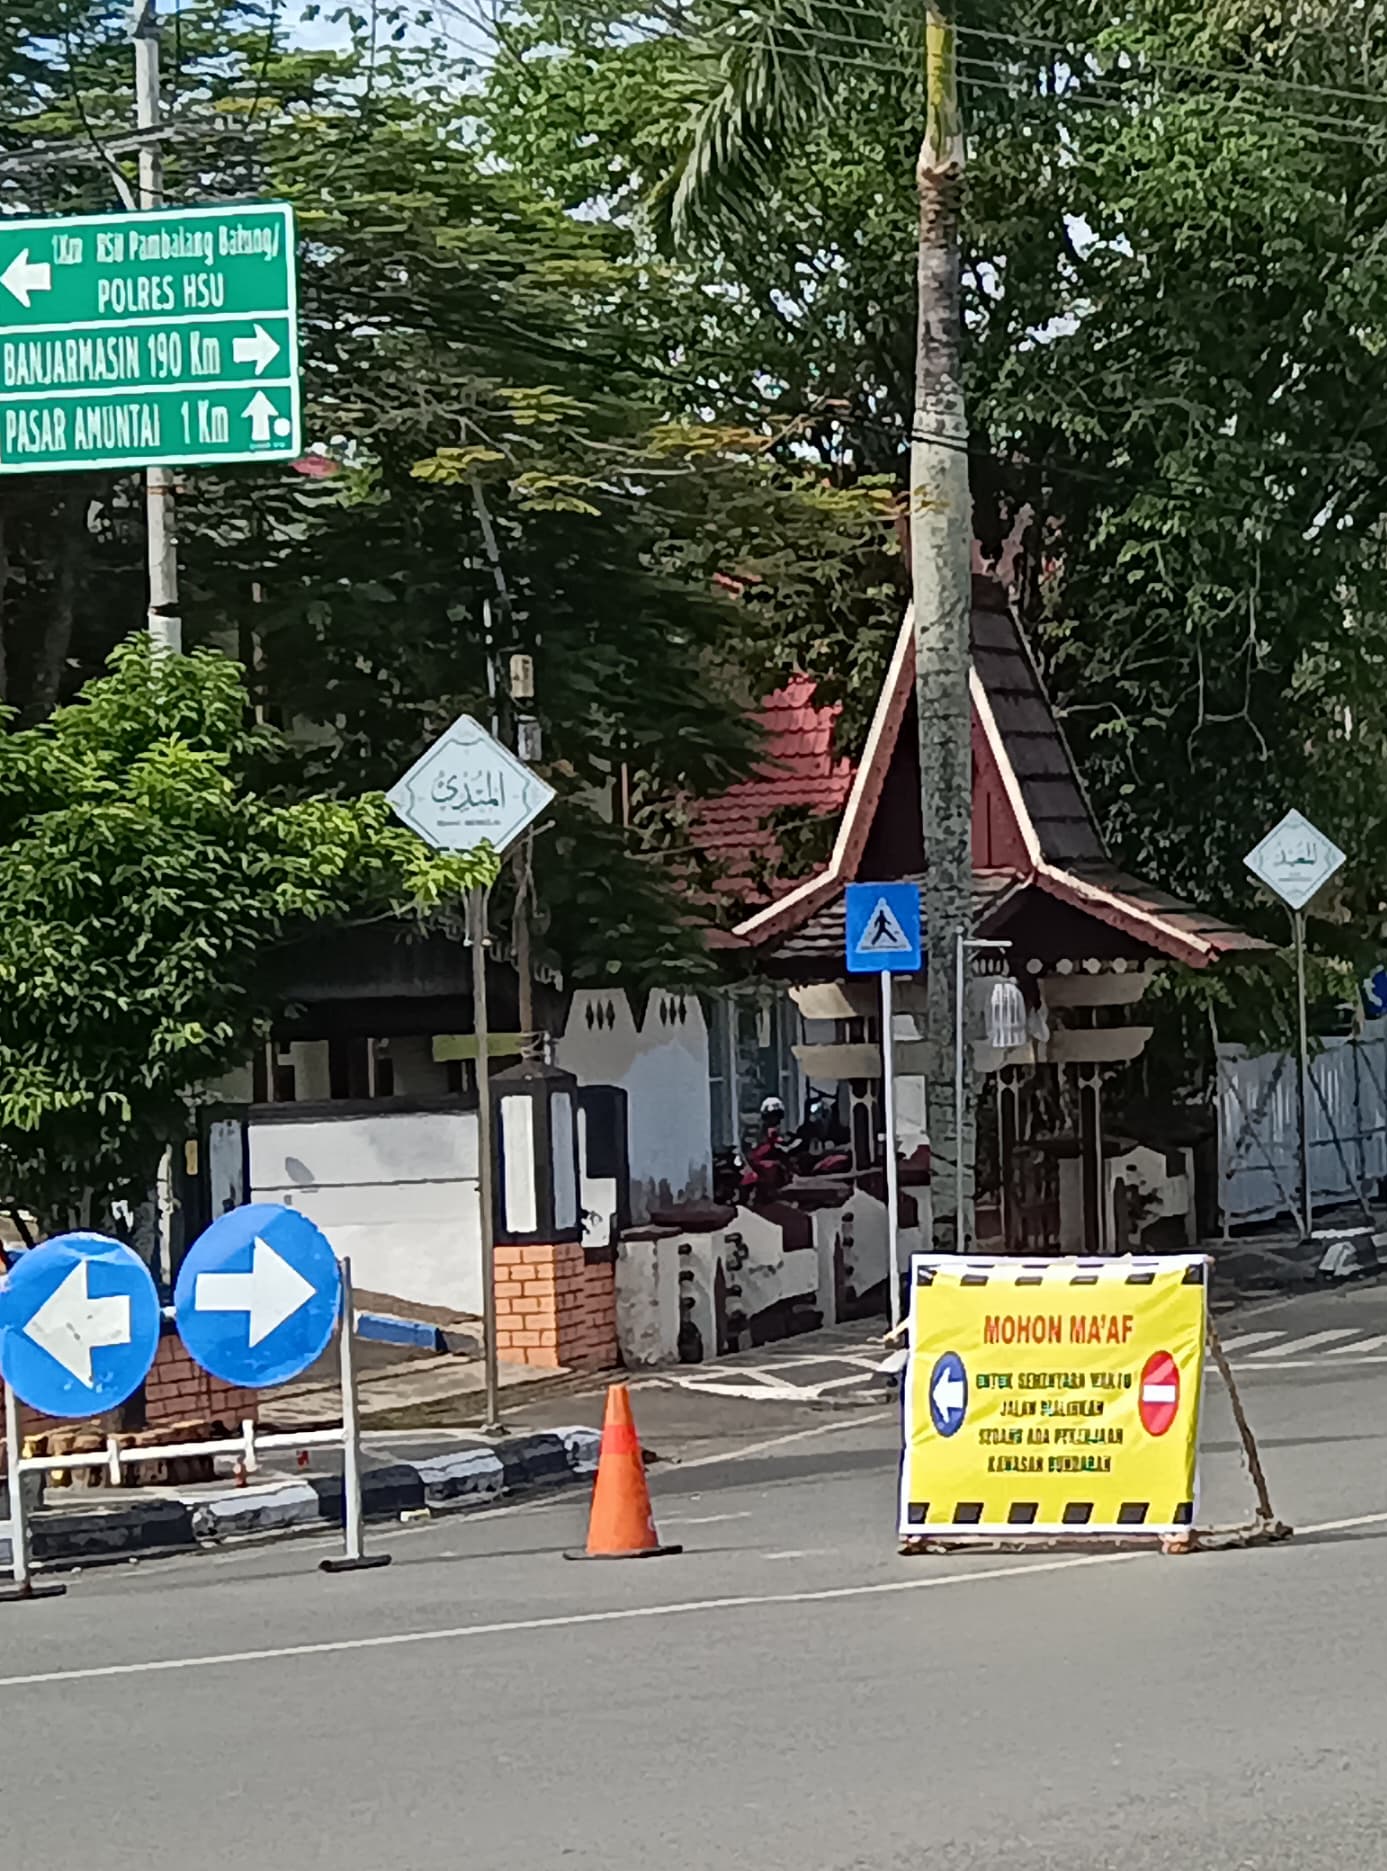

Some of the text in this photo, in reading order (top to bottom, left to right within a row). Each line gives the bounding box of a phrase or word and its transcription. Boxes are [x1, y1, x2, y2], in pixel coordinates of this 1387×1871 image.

[98, 273, 224, 313] POLRES HSU
[3, 331, 220, 387] BANJARMASIN 190 Km
[6, 400, 229, 453] PASAR AMUNTAI 1 Km
[983, 1314, 1134, 1344] MOHON MA'AF
[976, 1372, 1013, 1389] UNTUK
[1000, 1400, 1036, 1417] JALAN
[979, 1428, 1023, 1445] SEDANG
[1027, 1428, 1050, 1445] ADA
[988, 1455, 1043, 1473] KAWASAN
